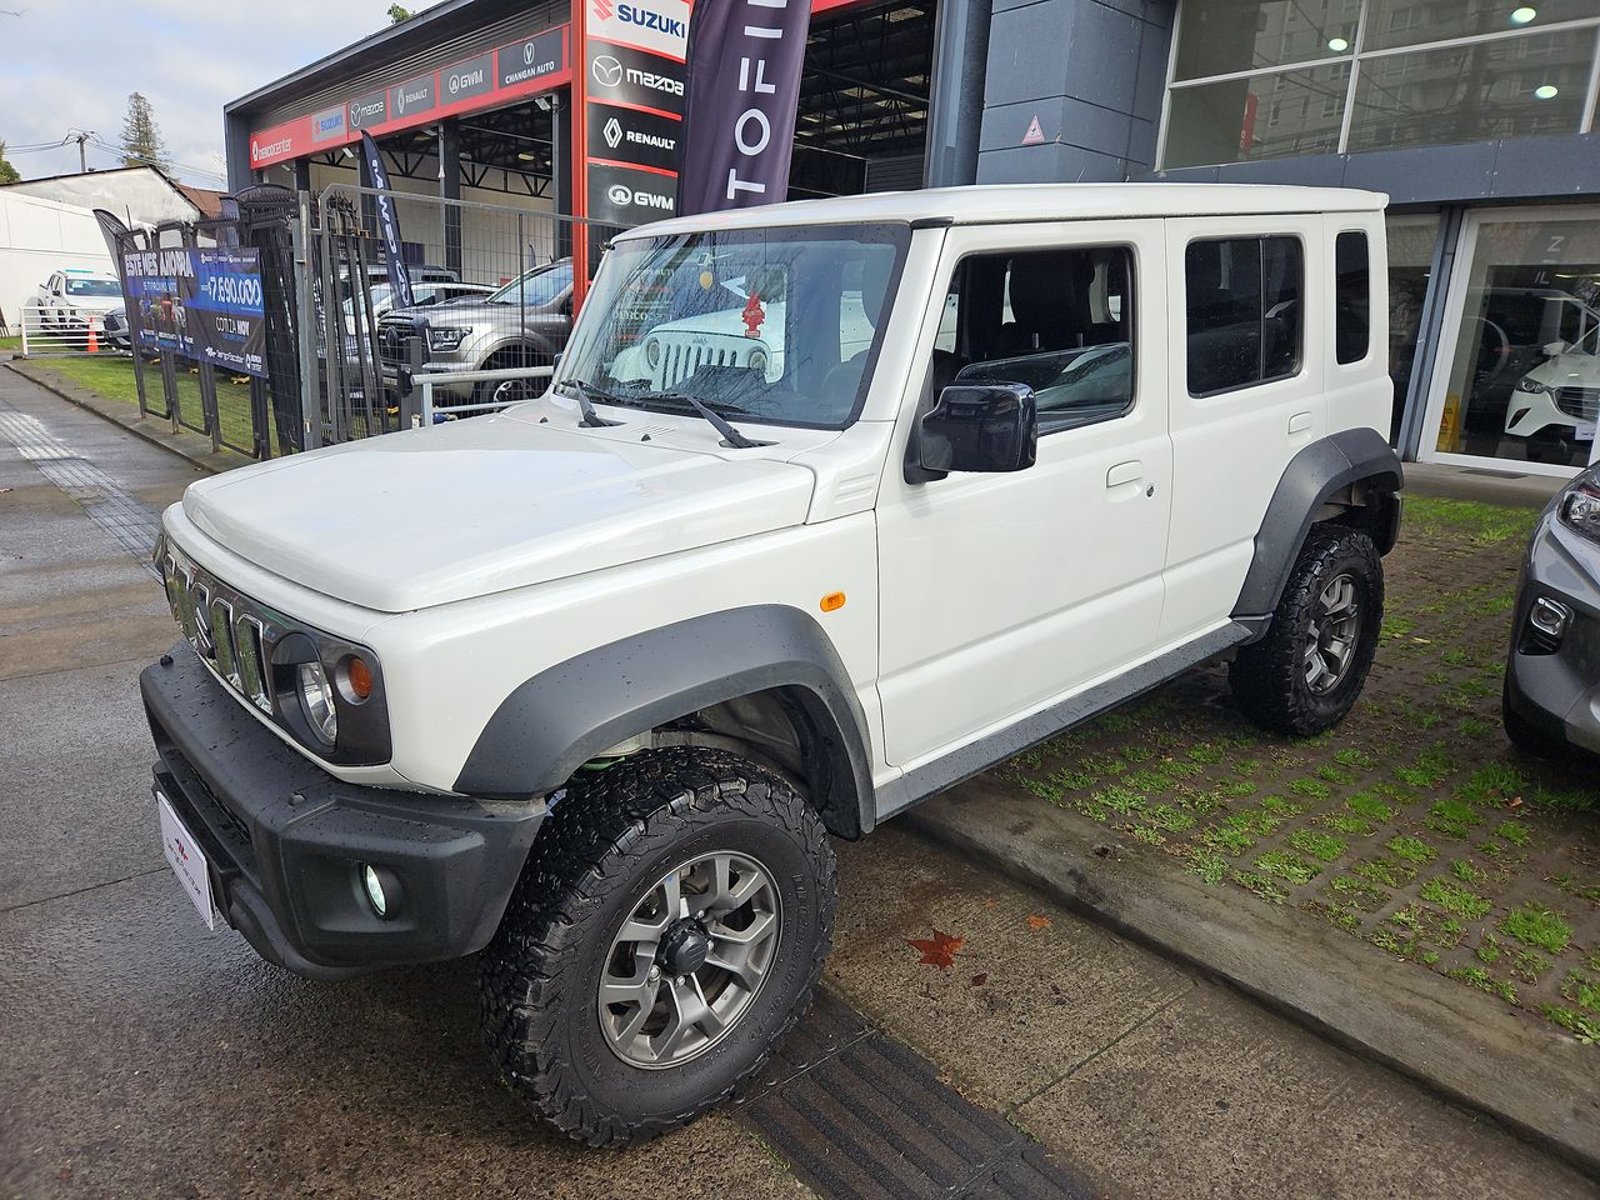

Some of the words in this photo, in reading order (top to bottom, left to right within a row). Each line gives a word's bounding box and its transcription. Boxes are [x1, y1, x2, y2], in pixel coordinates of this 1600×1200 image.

[617, 4, 685, 39] SUZUKI
[460, 69, 484, 89] GWM
[505, 67, 536, 85] CHANGAN
[535, 60, 555, 75] AUTO
[405, 88, 428, 104] RENAULT
[727, 0, 788, 200] TOFI
[320, 114, 343, 132] SUZUKI
[626, 130, 676, 150] RENAULT
[634, 190, 674, 211] GWM
[125, 254, 142, 276] ESTE
[142, 252, 158, 276] MES
[160, 251, 194, 278] AHORRA
